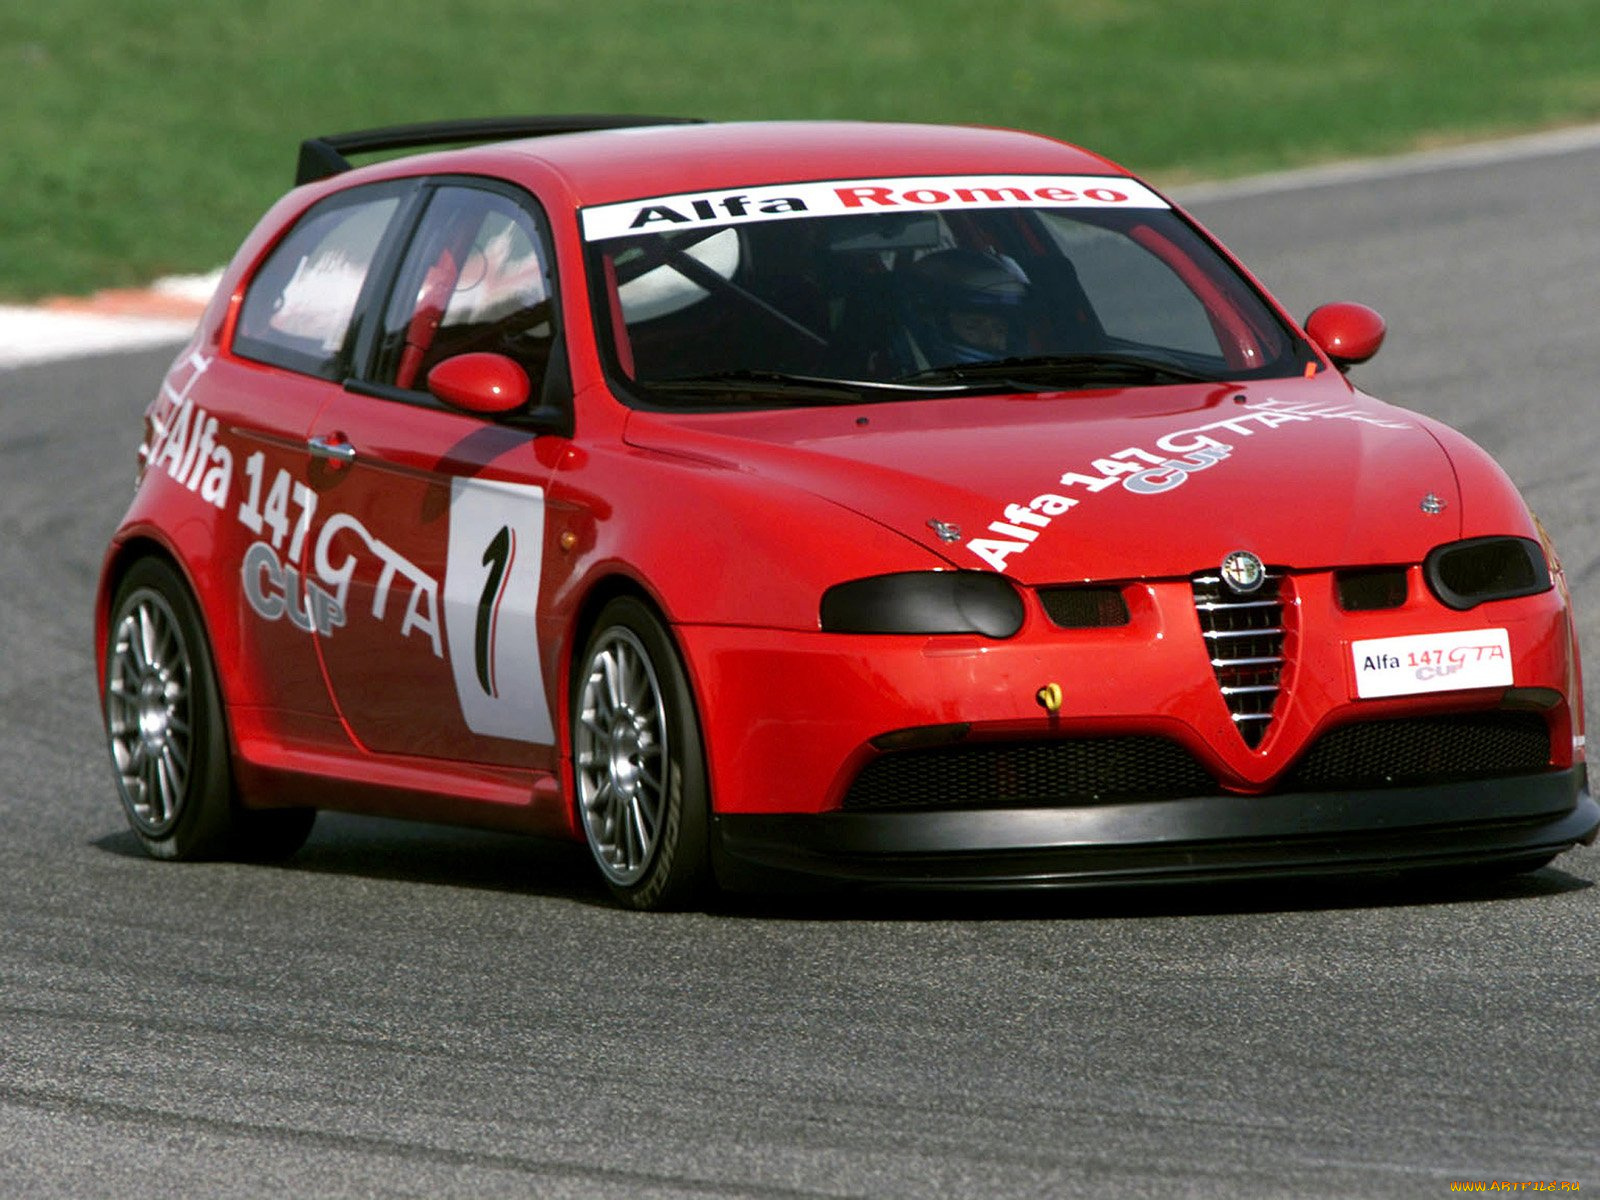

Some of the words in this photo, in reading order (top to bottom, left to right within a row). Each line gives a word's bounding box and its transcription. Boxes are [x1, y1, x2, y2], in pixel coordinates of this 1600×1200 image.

[629, 195, 808, 229] Alfa
[832, 185, 1129, 208] Romeo
[156, 398, 234, 510] Alfa
[238, 451, 318, 563] 147
[315, 513, 444, 659] GTA
[965, 493, 1080, 573] Alfa
[1060, 447, 1168, 493] 147
[1156, 411, 1312, 453] GTA
[475, 525, 516, 699] 1
[1364, 653, 1401, 671] Alfa
[1408, 649, 1444, 667] 147
[1448, 645, 1504, 669] GTA
